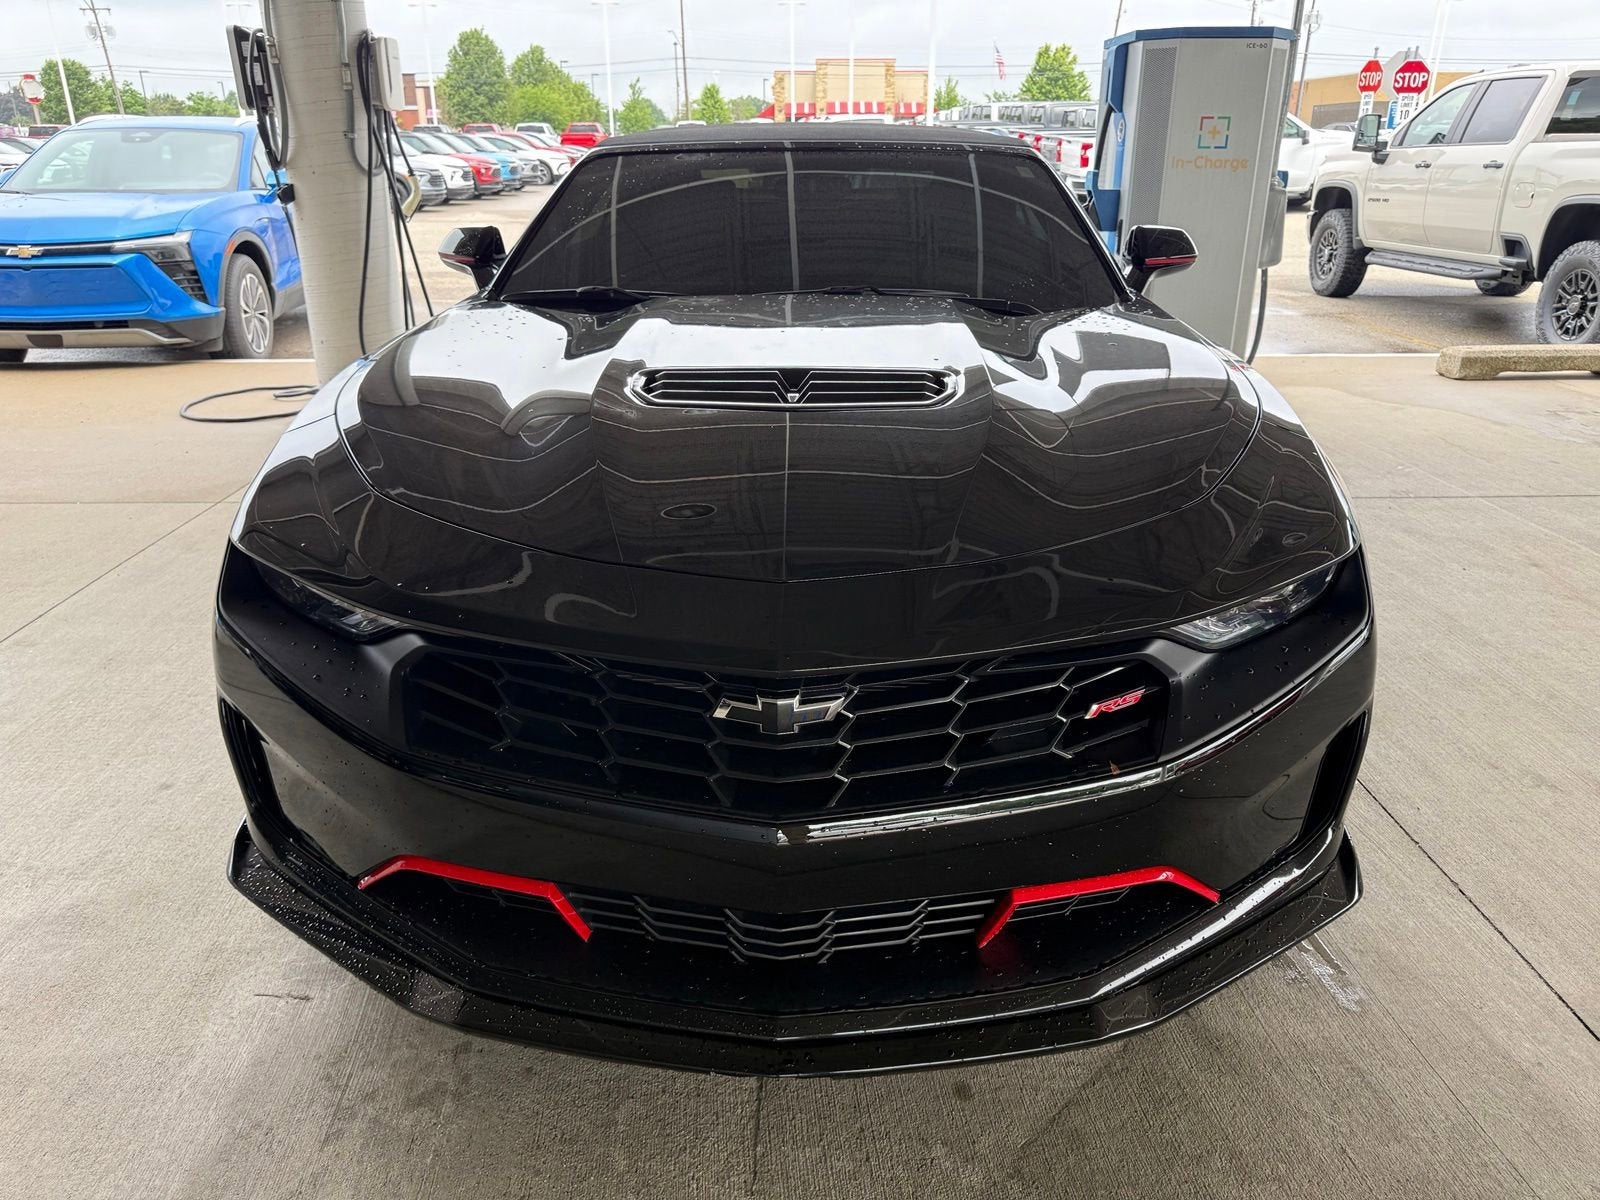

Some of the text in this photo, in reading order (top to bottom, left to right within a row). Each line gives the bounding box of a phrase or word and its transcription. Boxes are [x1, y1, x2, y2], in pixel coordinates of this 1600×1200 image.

[1360, 72, 1382, 87] STOP
[1395, 73, 1428, 88] STOP
[1400, 109, 1410, 120] 10
[1171, 155, 1249, 173] In-Charge
[1084, 688, 1146, 719] RS
